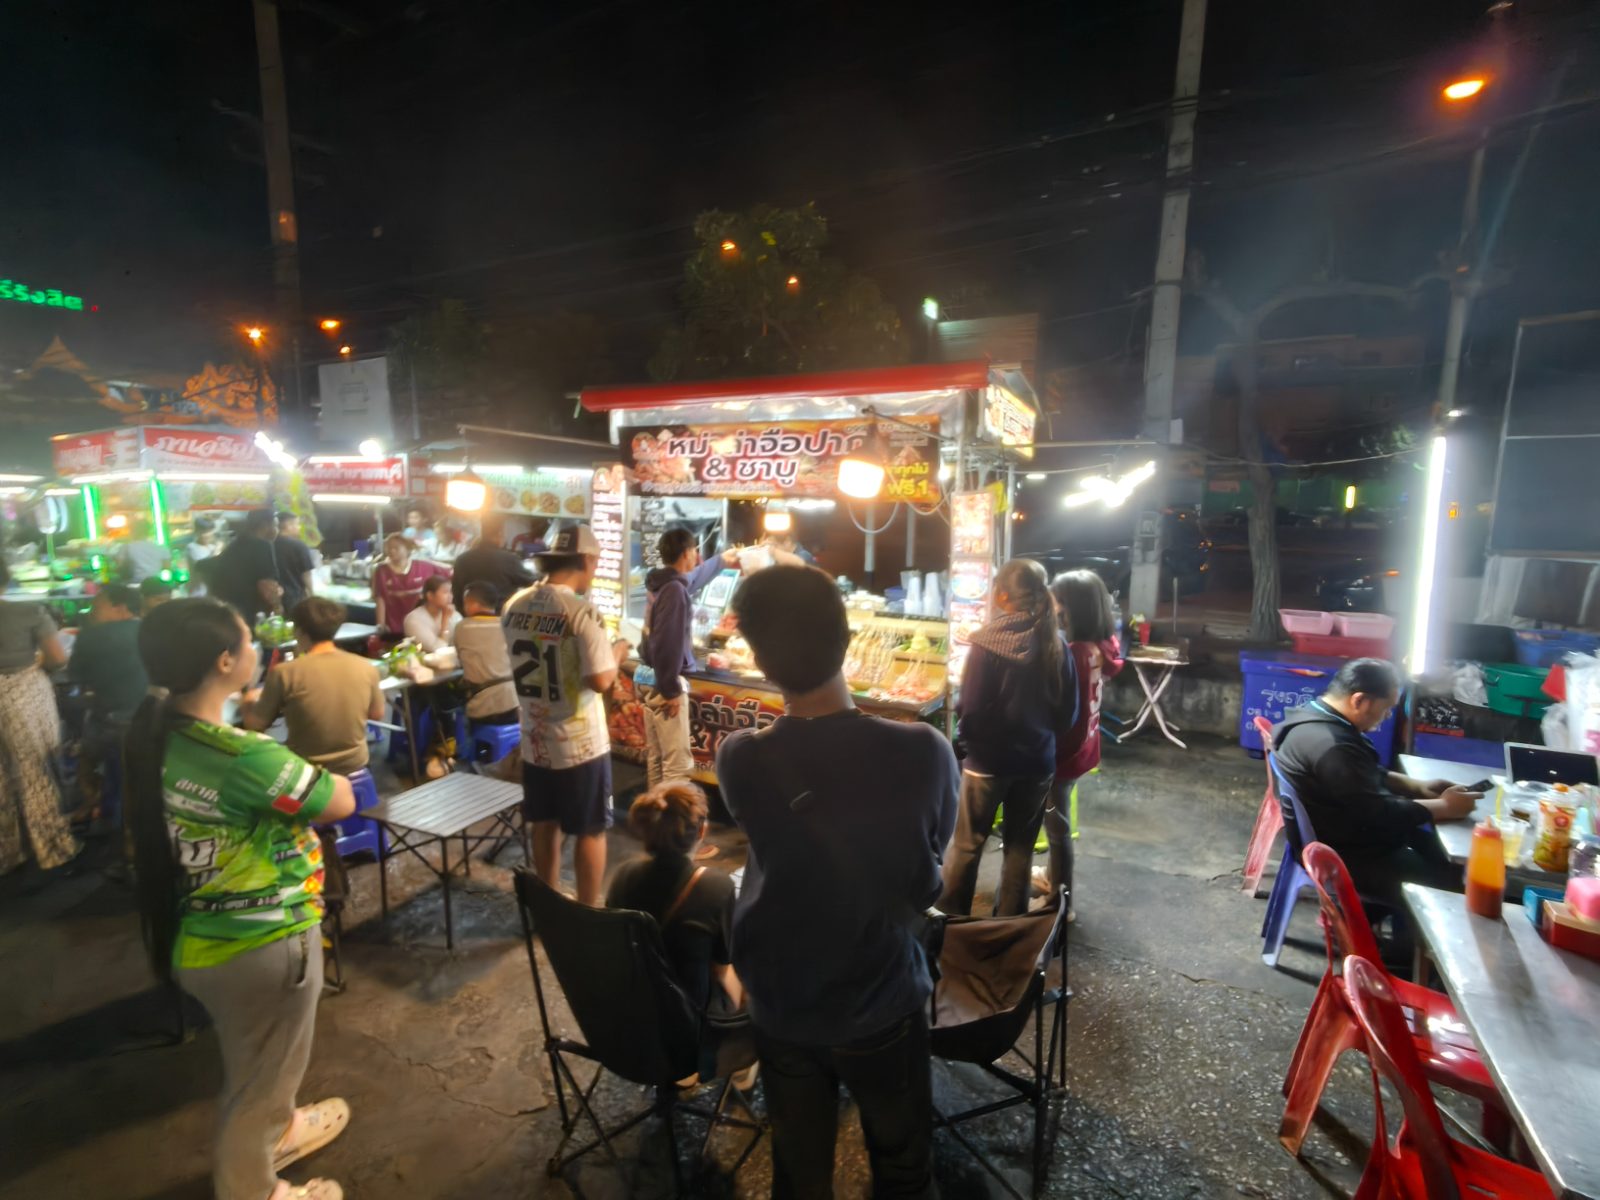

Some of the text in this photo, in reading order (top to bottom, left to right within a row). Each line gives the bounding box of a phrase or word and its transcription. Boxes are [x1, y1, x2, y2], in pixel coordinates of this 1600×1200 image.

[705, 457, 797, 485] & ชาบู
[917, 479, 928, 496] 1
[512, 638, 561, 703] 21
